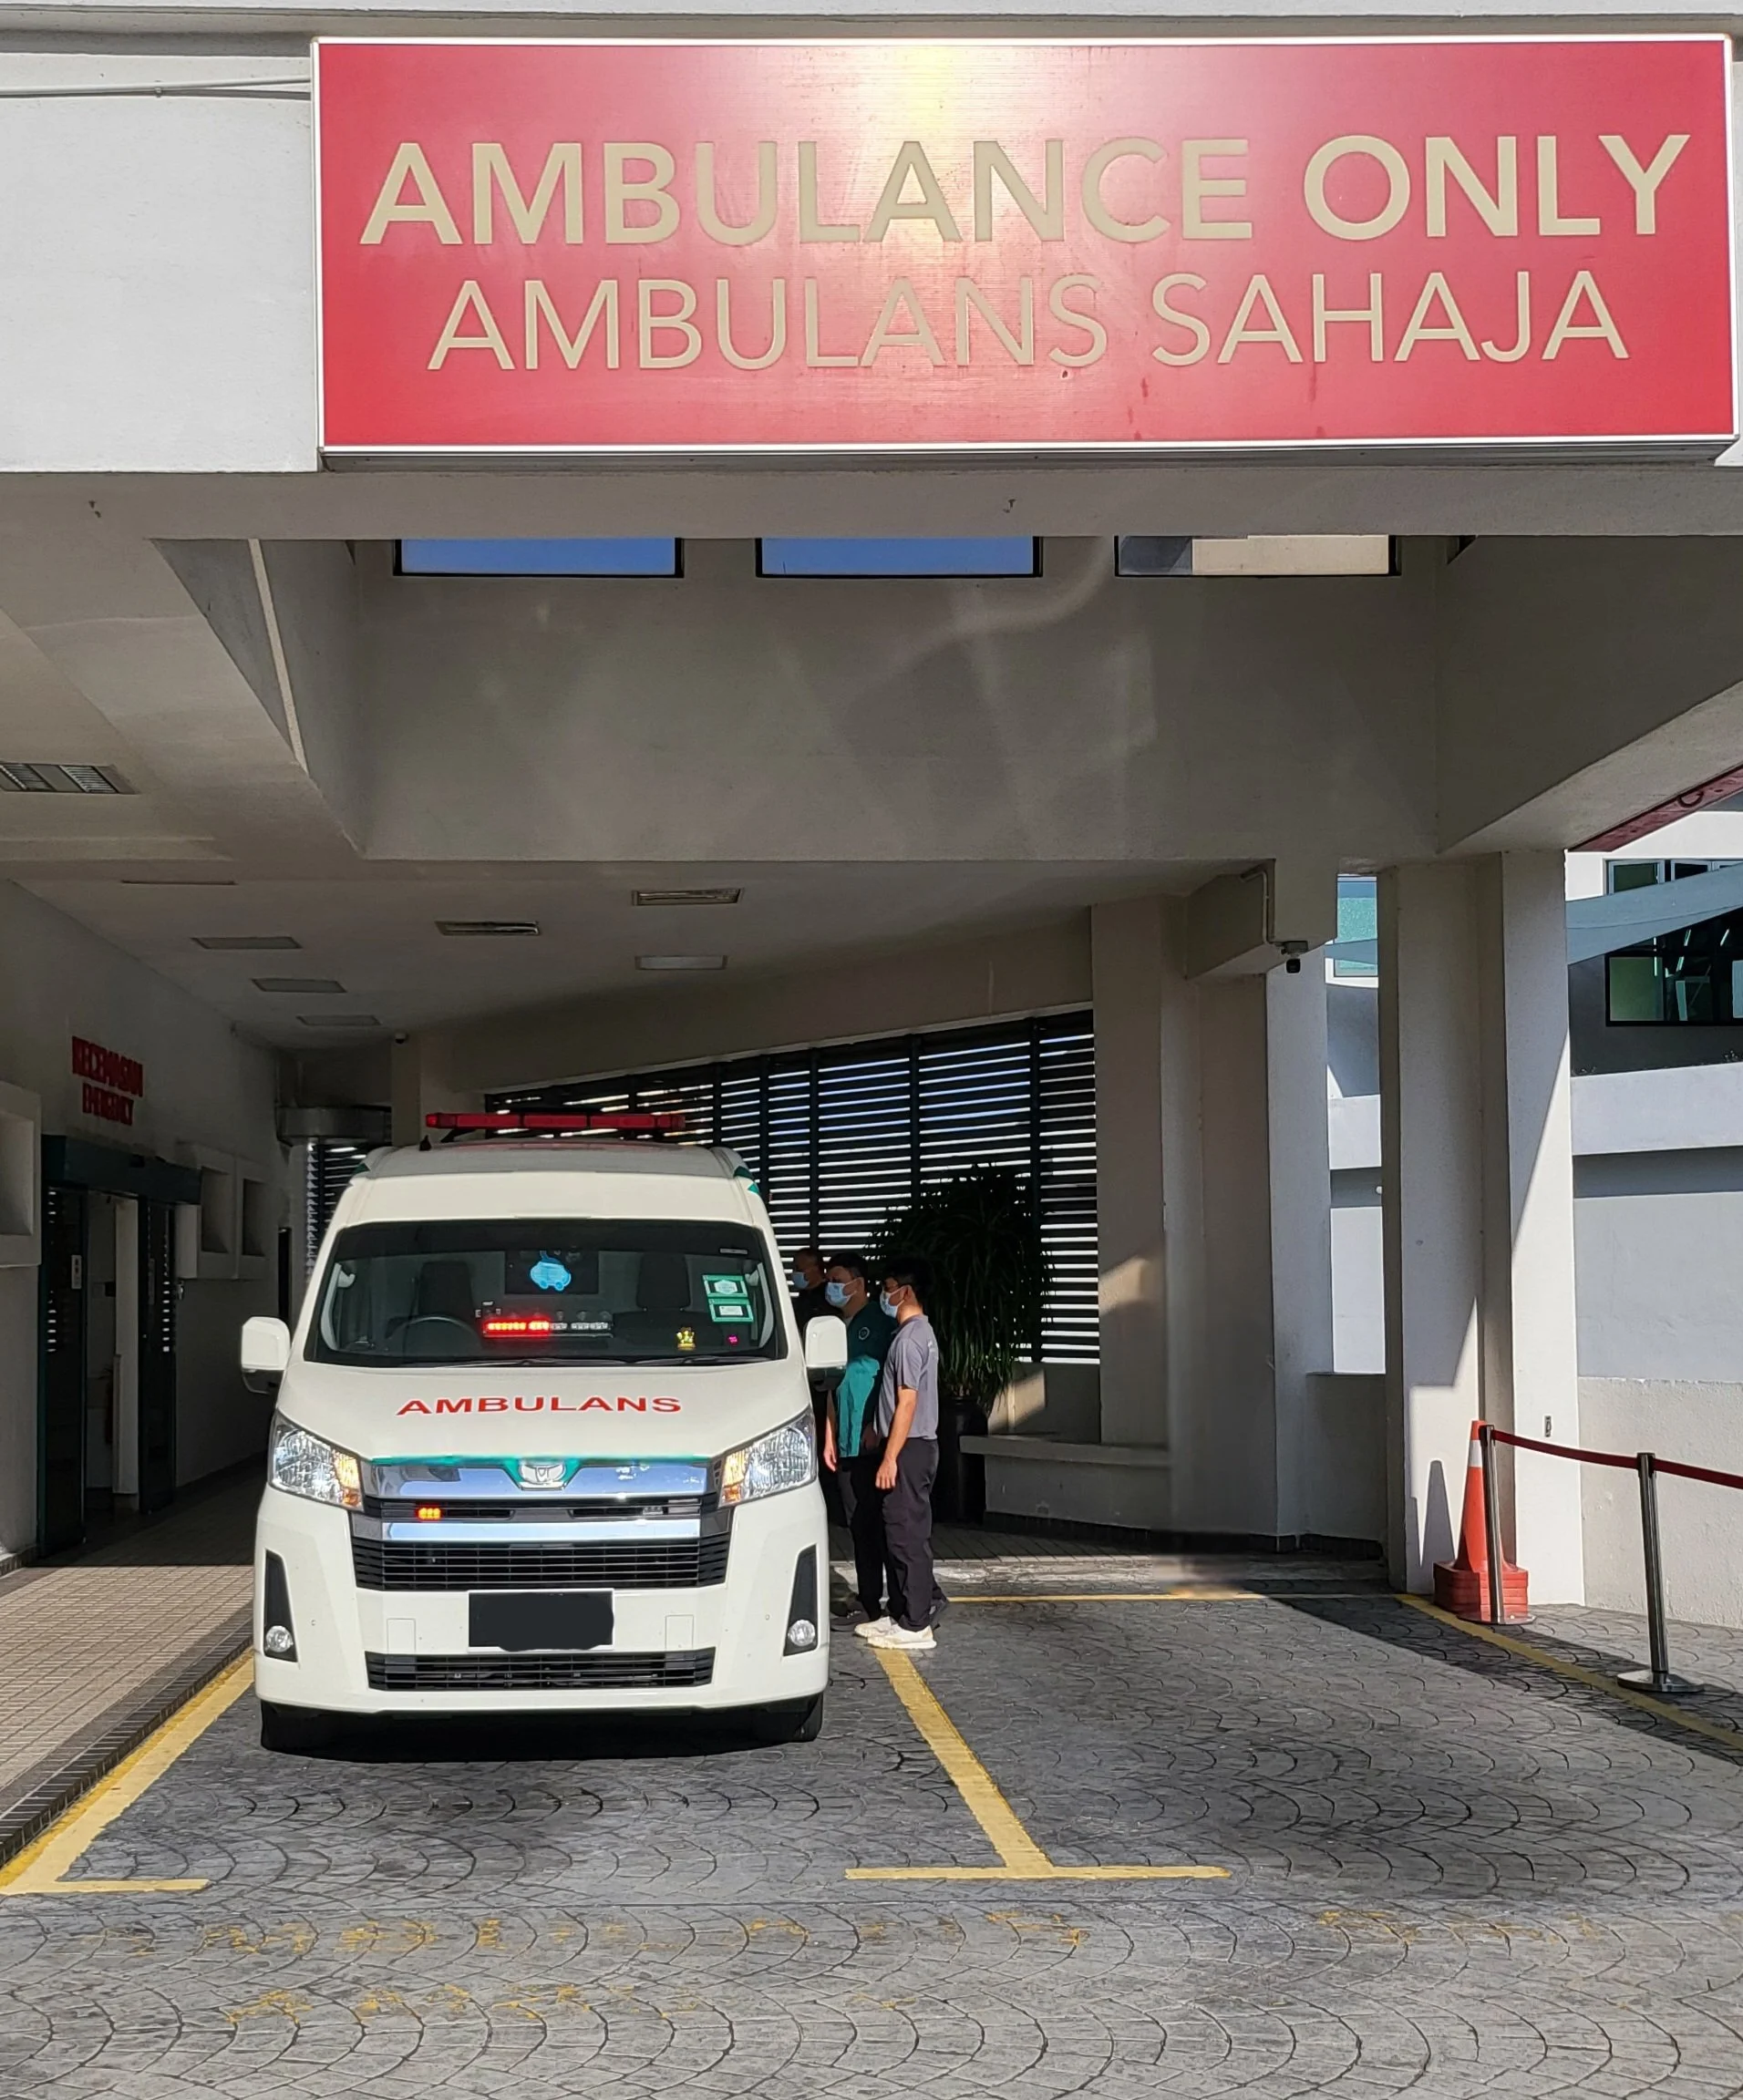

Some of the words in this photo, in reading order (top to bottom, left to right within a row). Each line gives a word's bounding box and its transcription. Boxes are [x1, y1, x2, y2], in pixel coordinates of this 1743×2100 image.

[359, 138, 1253, 247] AMBULANCE
[1304, 134, 1691, 241] ONLY
[427, 274, 1109, 371] AMBULANS
[1151, 271, 1630, 366] SAHAJA
[396, 1395, 682, 1416] AMBULANS
